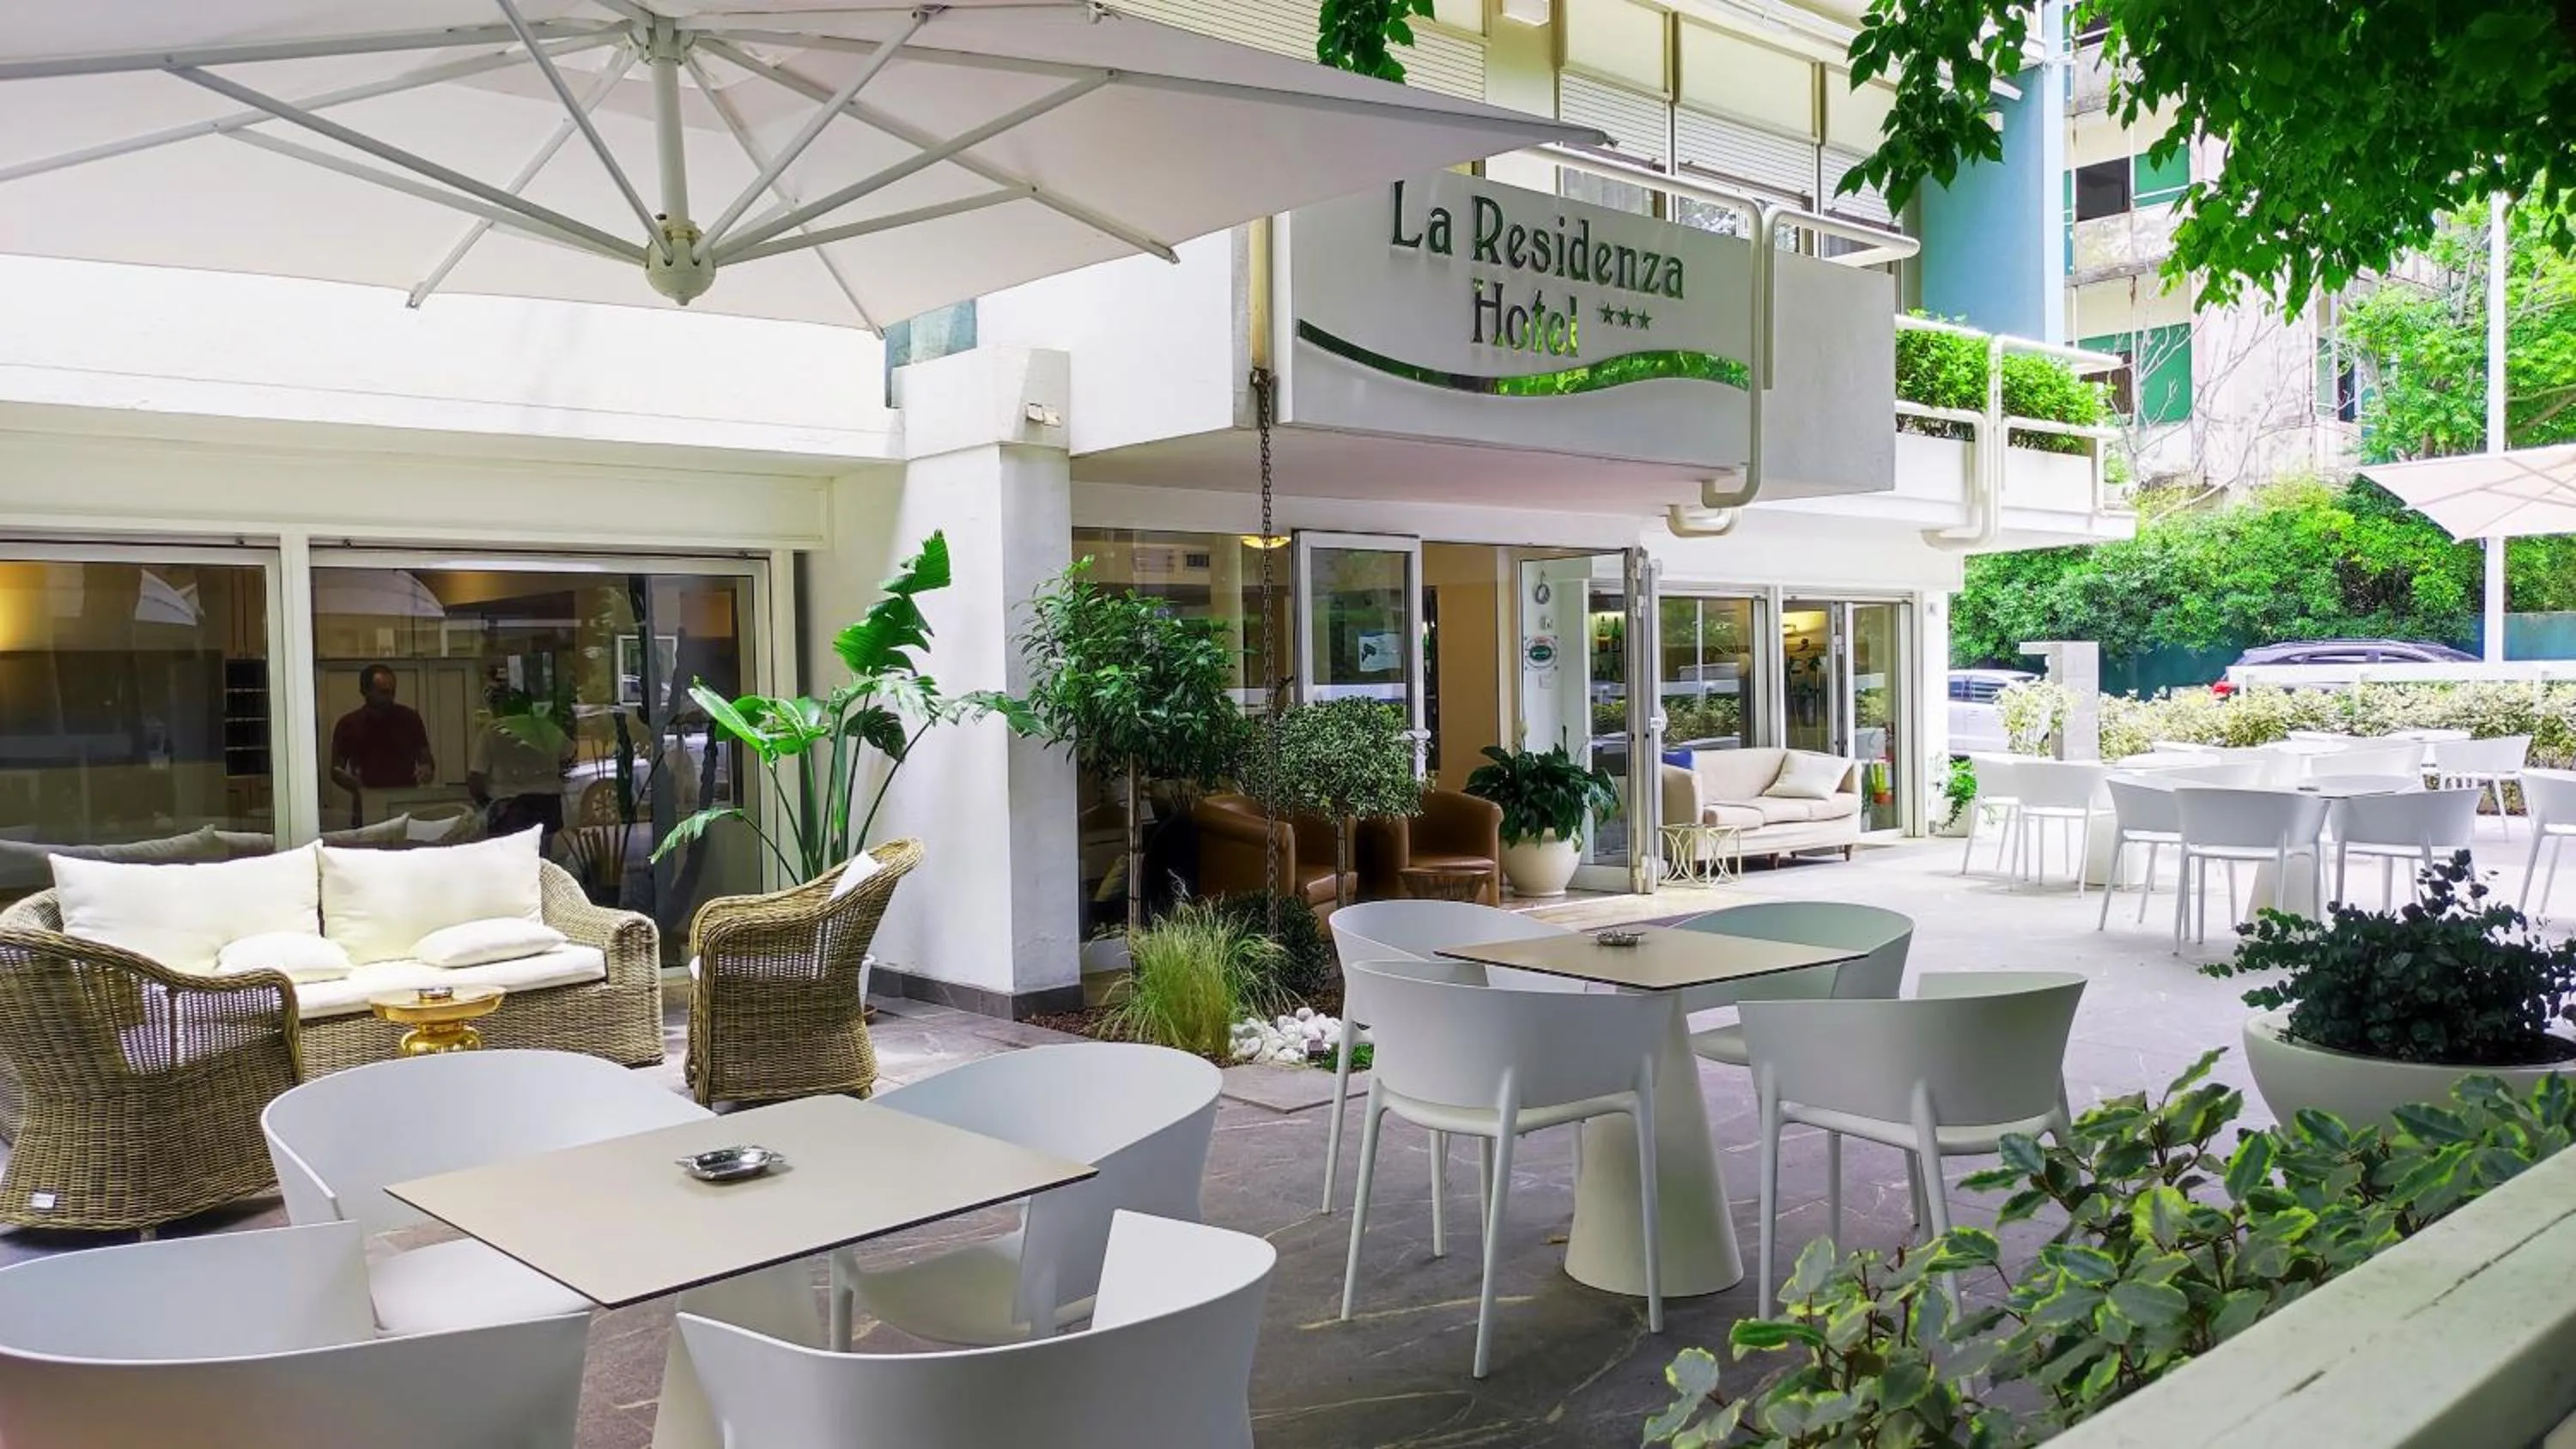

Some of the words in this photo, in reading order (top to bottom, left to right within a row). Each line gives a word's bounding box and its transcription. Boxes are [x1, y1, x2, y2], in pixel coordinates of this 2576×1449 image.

[1390, 180, 1453, 256] La
[1471, 195, 1685, 300] Residenza
[1472, 279, 1579, 357] Hotel
